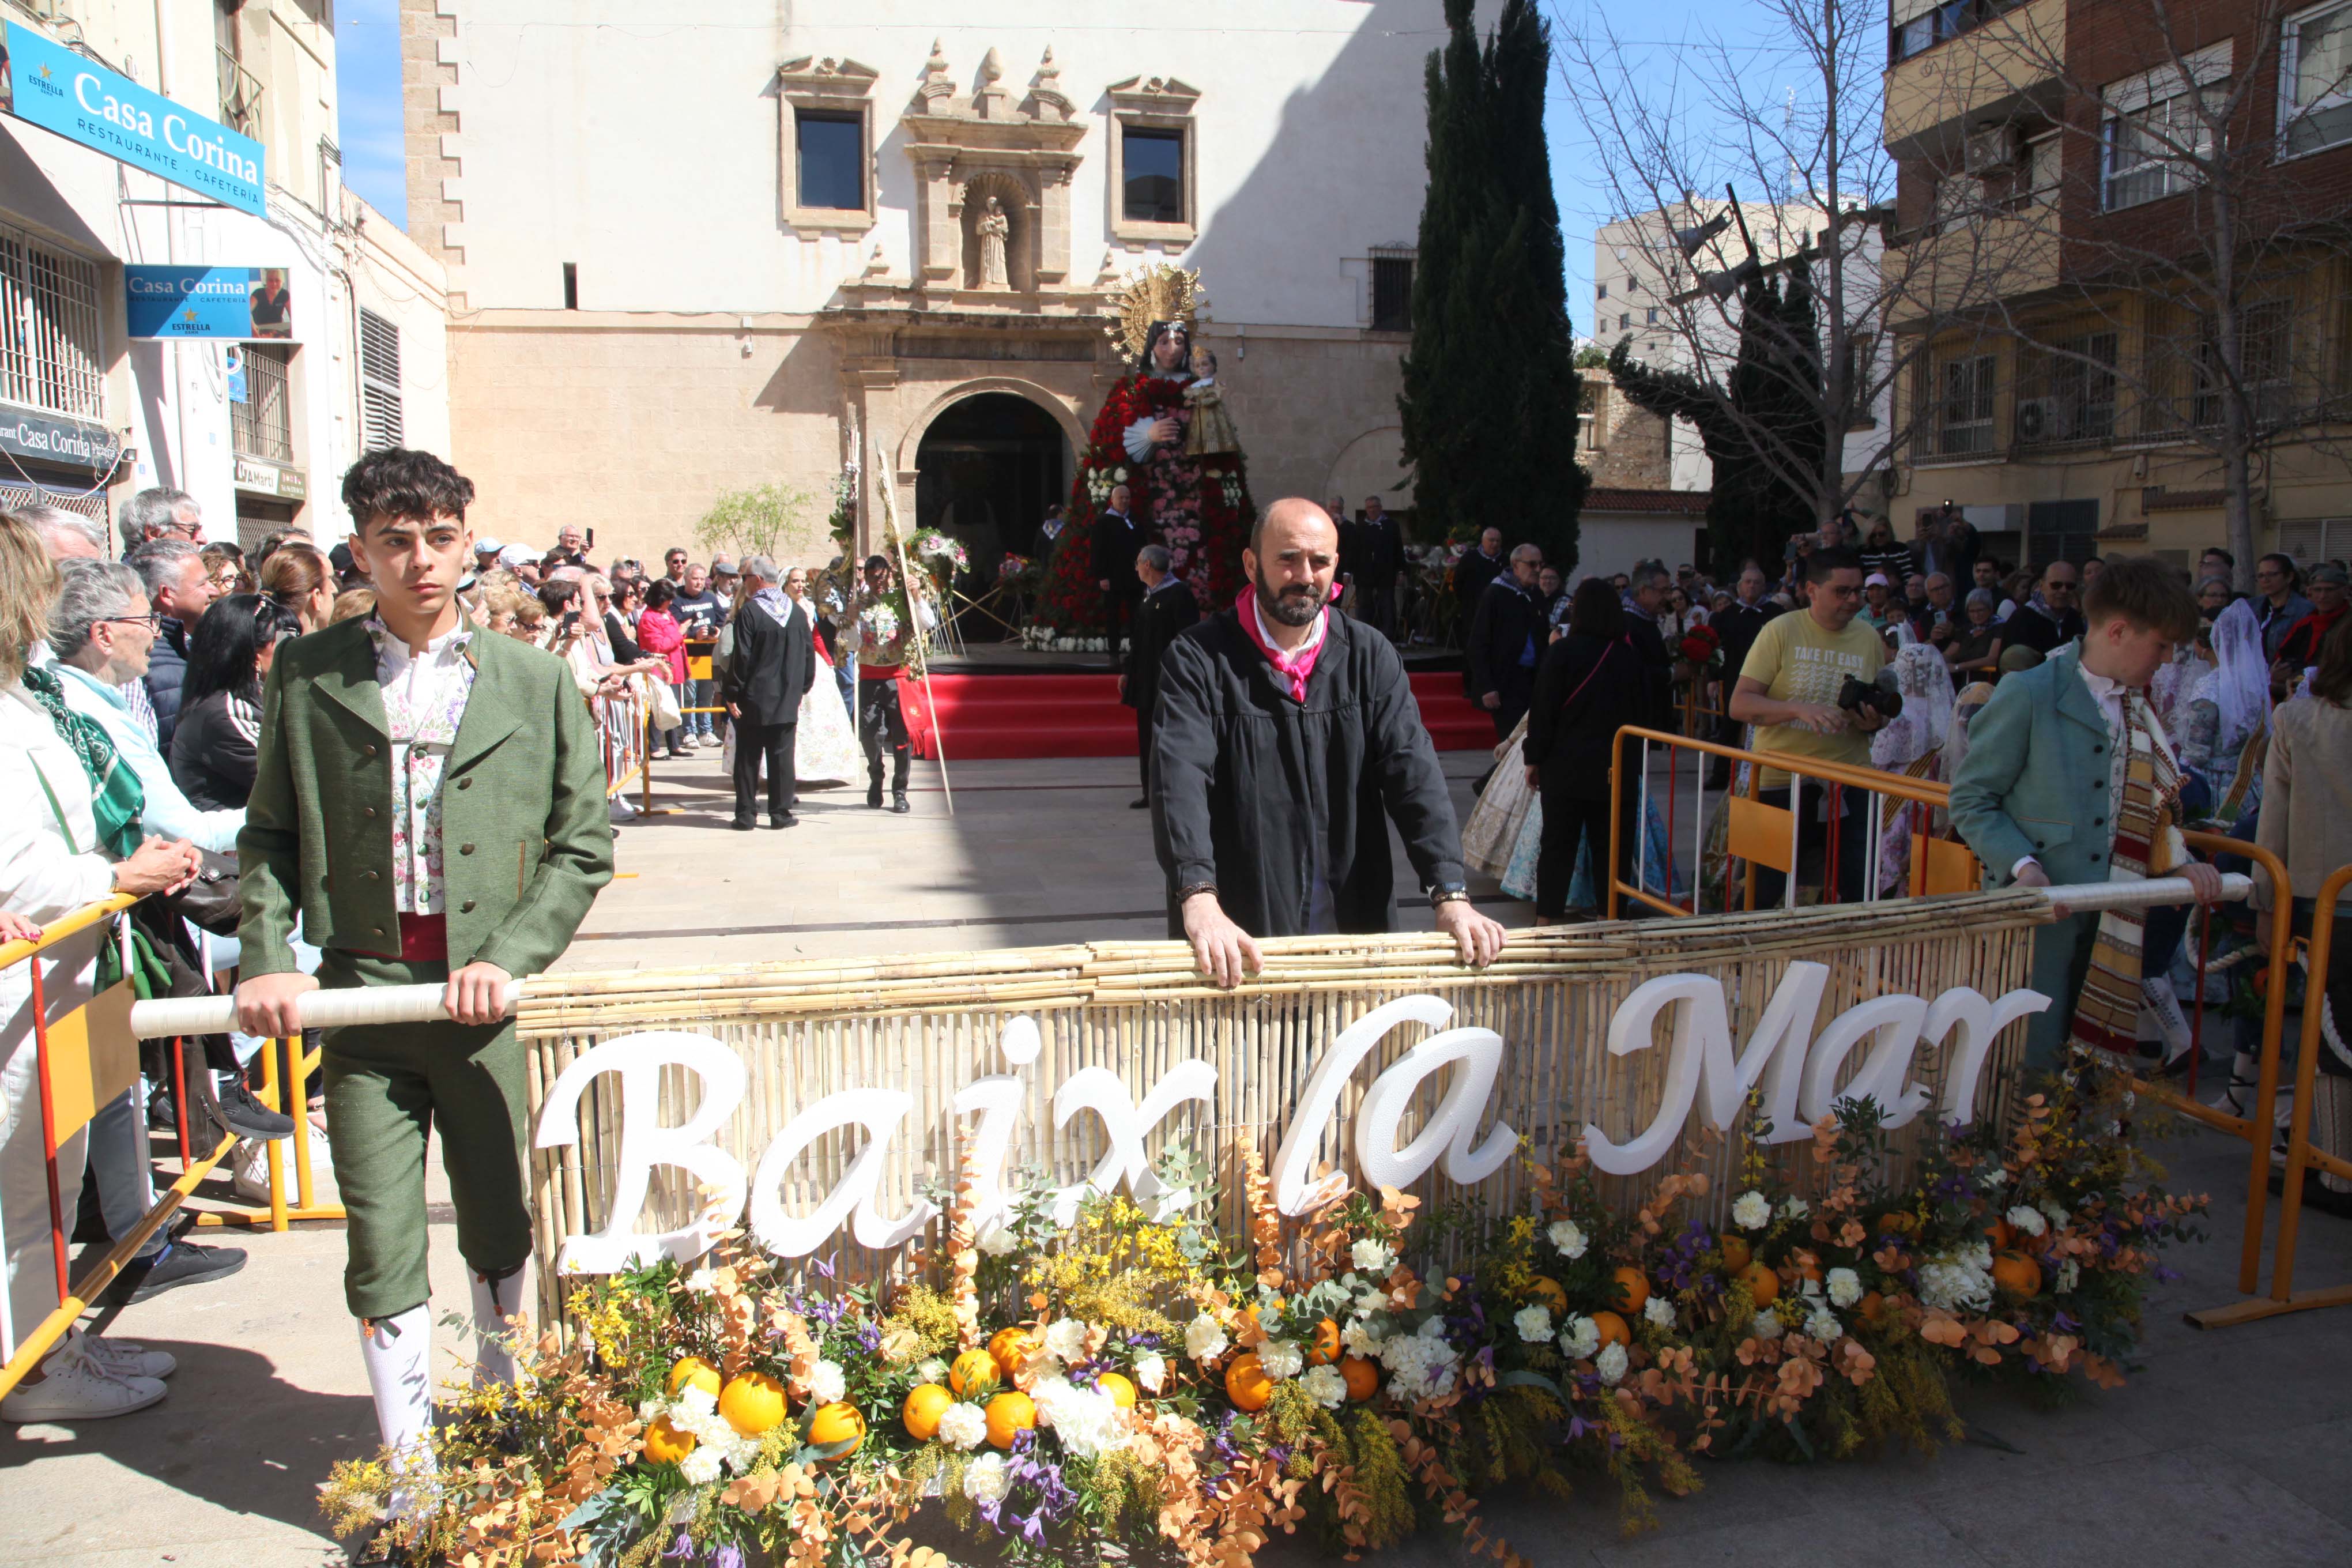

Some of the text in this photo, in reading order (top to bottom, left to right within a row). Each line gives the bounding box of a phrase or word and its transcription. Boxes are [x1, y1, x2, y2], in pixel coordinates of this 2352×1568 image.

[29, 74, 63, 97] ESTRELLA
[75, 73, 258, 186] Casa Corina
[78, 118, 178, 171] RESTAURANTE
[129, 277, 245, 295] Casa Corina
[172, 323, 210, 331] ESTRELLA
[18, 423, 49, 450] Casa
[51, 430, 91, 458] Corina
[1794, 646, 1864, 669] TAKE IT EASY
[536, 1015, 1218, 1275] Baix
[1582, 961, 2052, 1175] Mar
